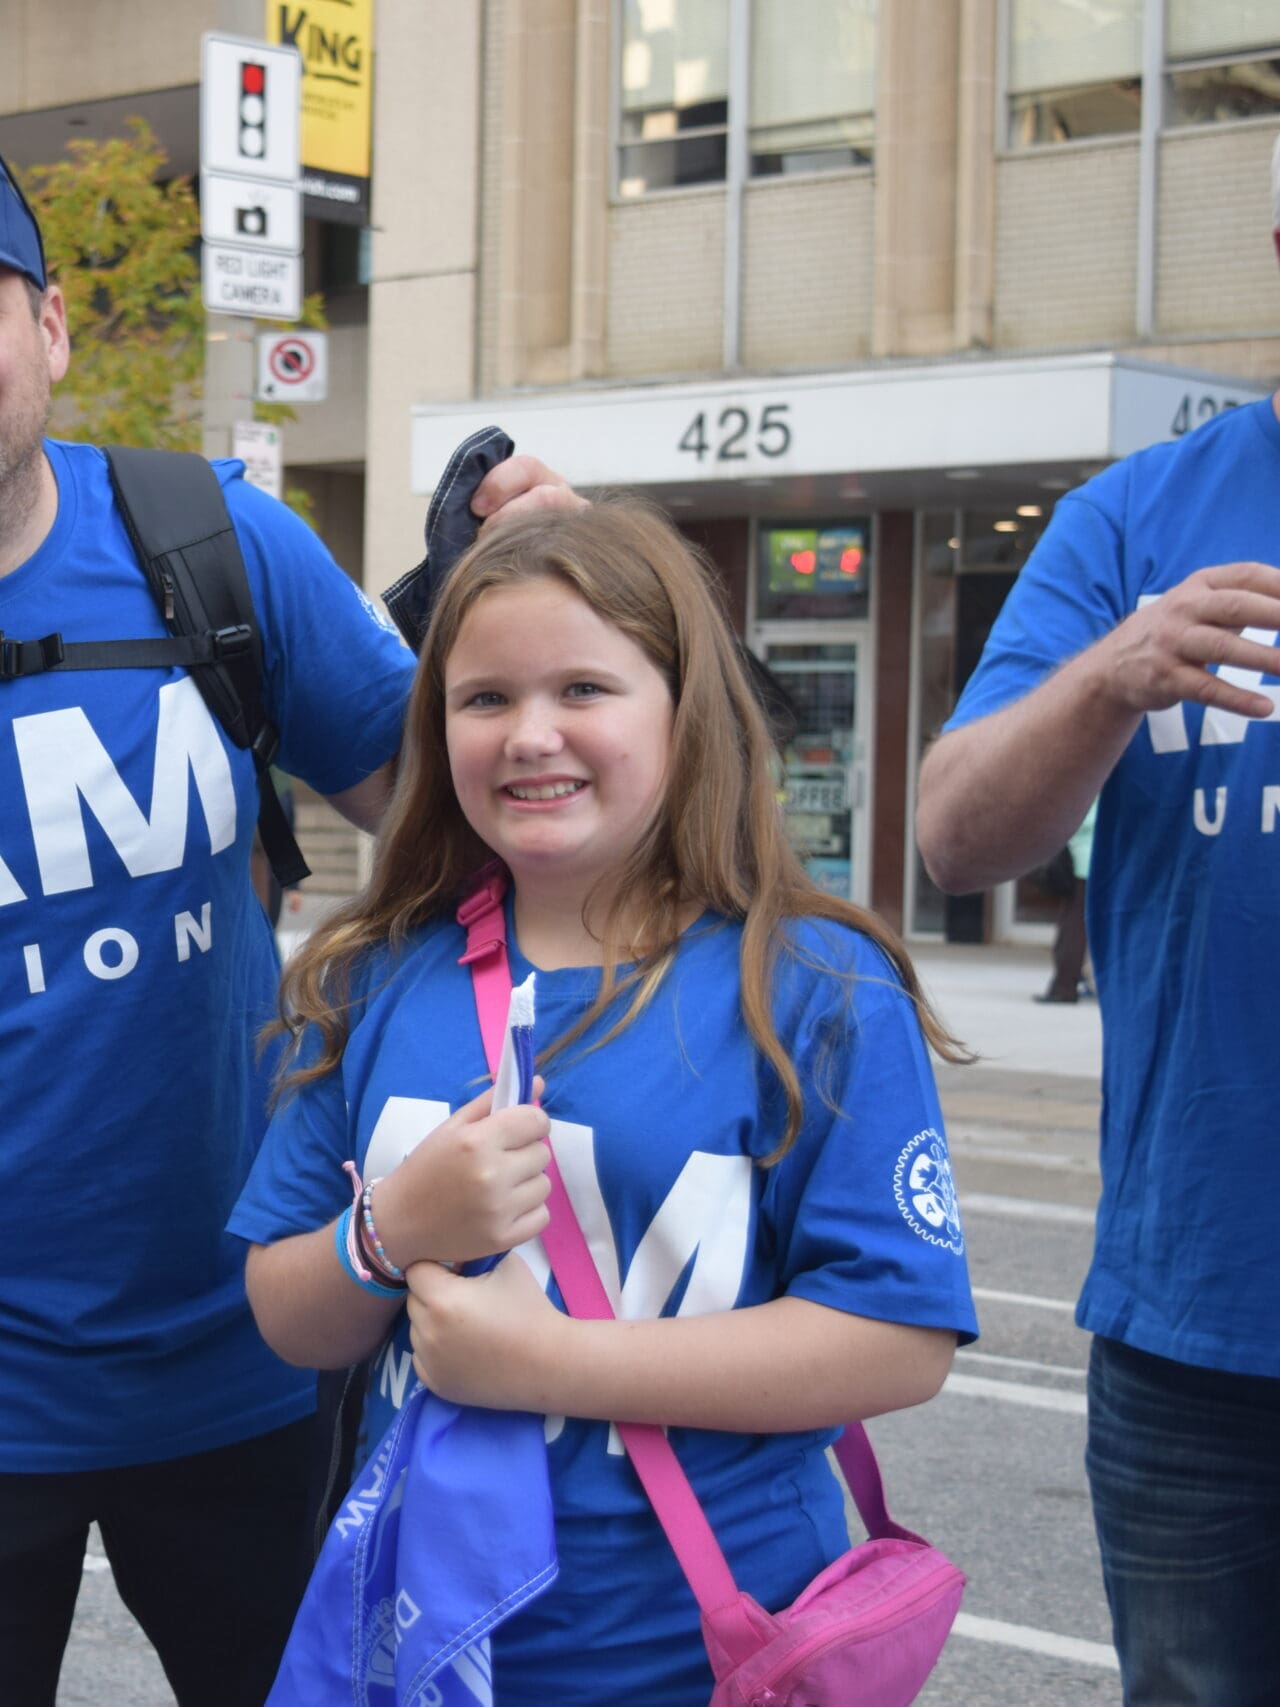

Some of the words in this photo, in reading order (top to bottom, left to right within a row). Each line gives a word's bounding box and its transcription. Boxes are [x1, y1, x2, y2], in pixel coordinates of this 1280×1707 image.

[216, 254, 242, 275] RED
[248, 260, 289, 281] LIGHT
[221, 283, 281, 305] CAMERA
[678, 404, 793, 462] 425
